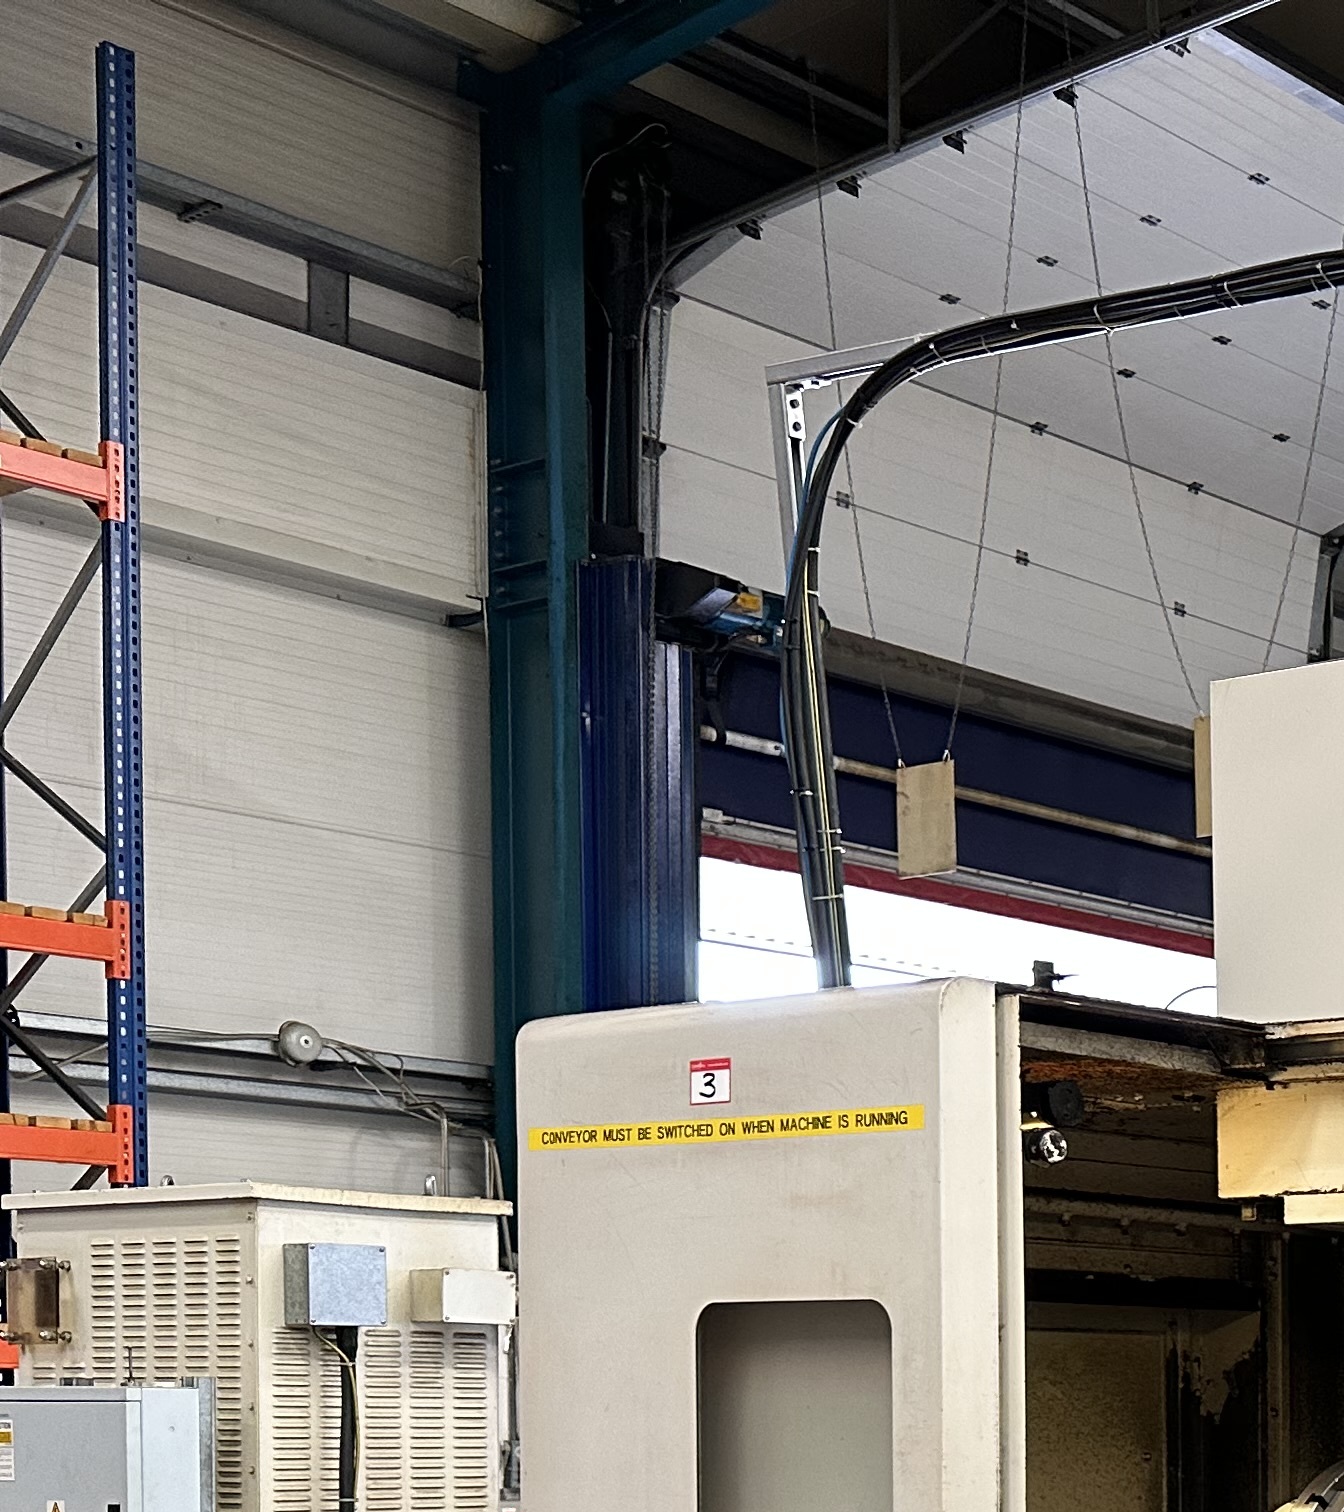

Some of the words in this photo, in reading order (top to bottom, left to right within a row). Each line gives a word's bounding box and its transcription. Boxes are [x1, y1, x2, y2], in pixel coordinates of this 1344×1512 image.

[699, 1072, 716, 1098] 3
[541, 1129, 598, 1145] CONVEYOR
[603, 1128, 633, 1142] MUST
[638, 1127, 651, 1140] BE
[657, 1124, 714, 1139] SWITCHED
[719, 1122, 736, 1136] ON
[742, 1119, 775, 1134] WHEN
[780, 1115, 832, 1132] MACHINE
[838, 1114, 849, 1128] IS
[855, 1111, 908, 1127] RUNNING
